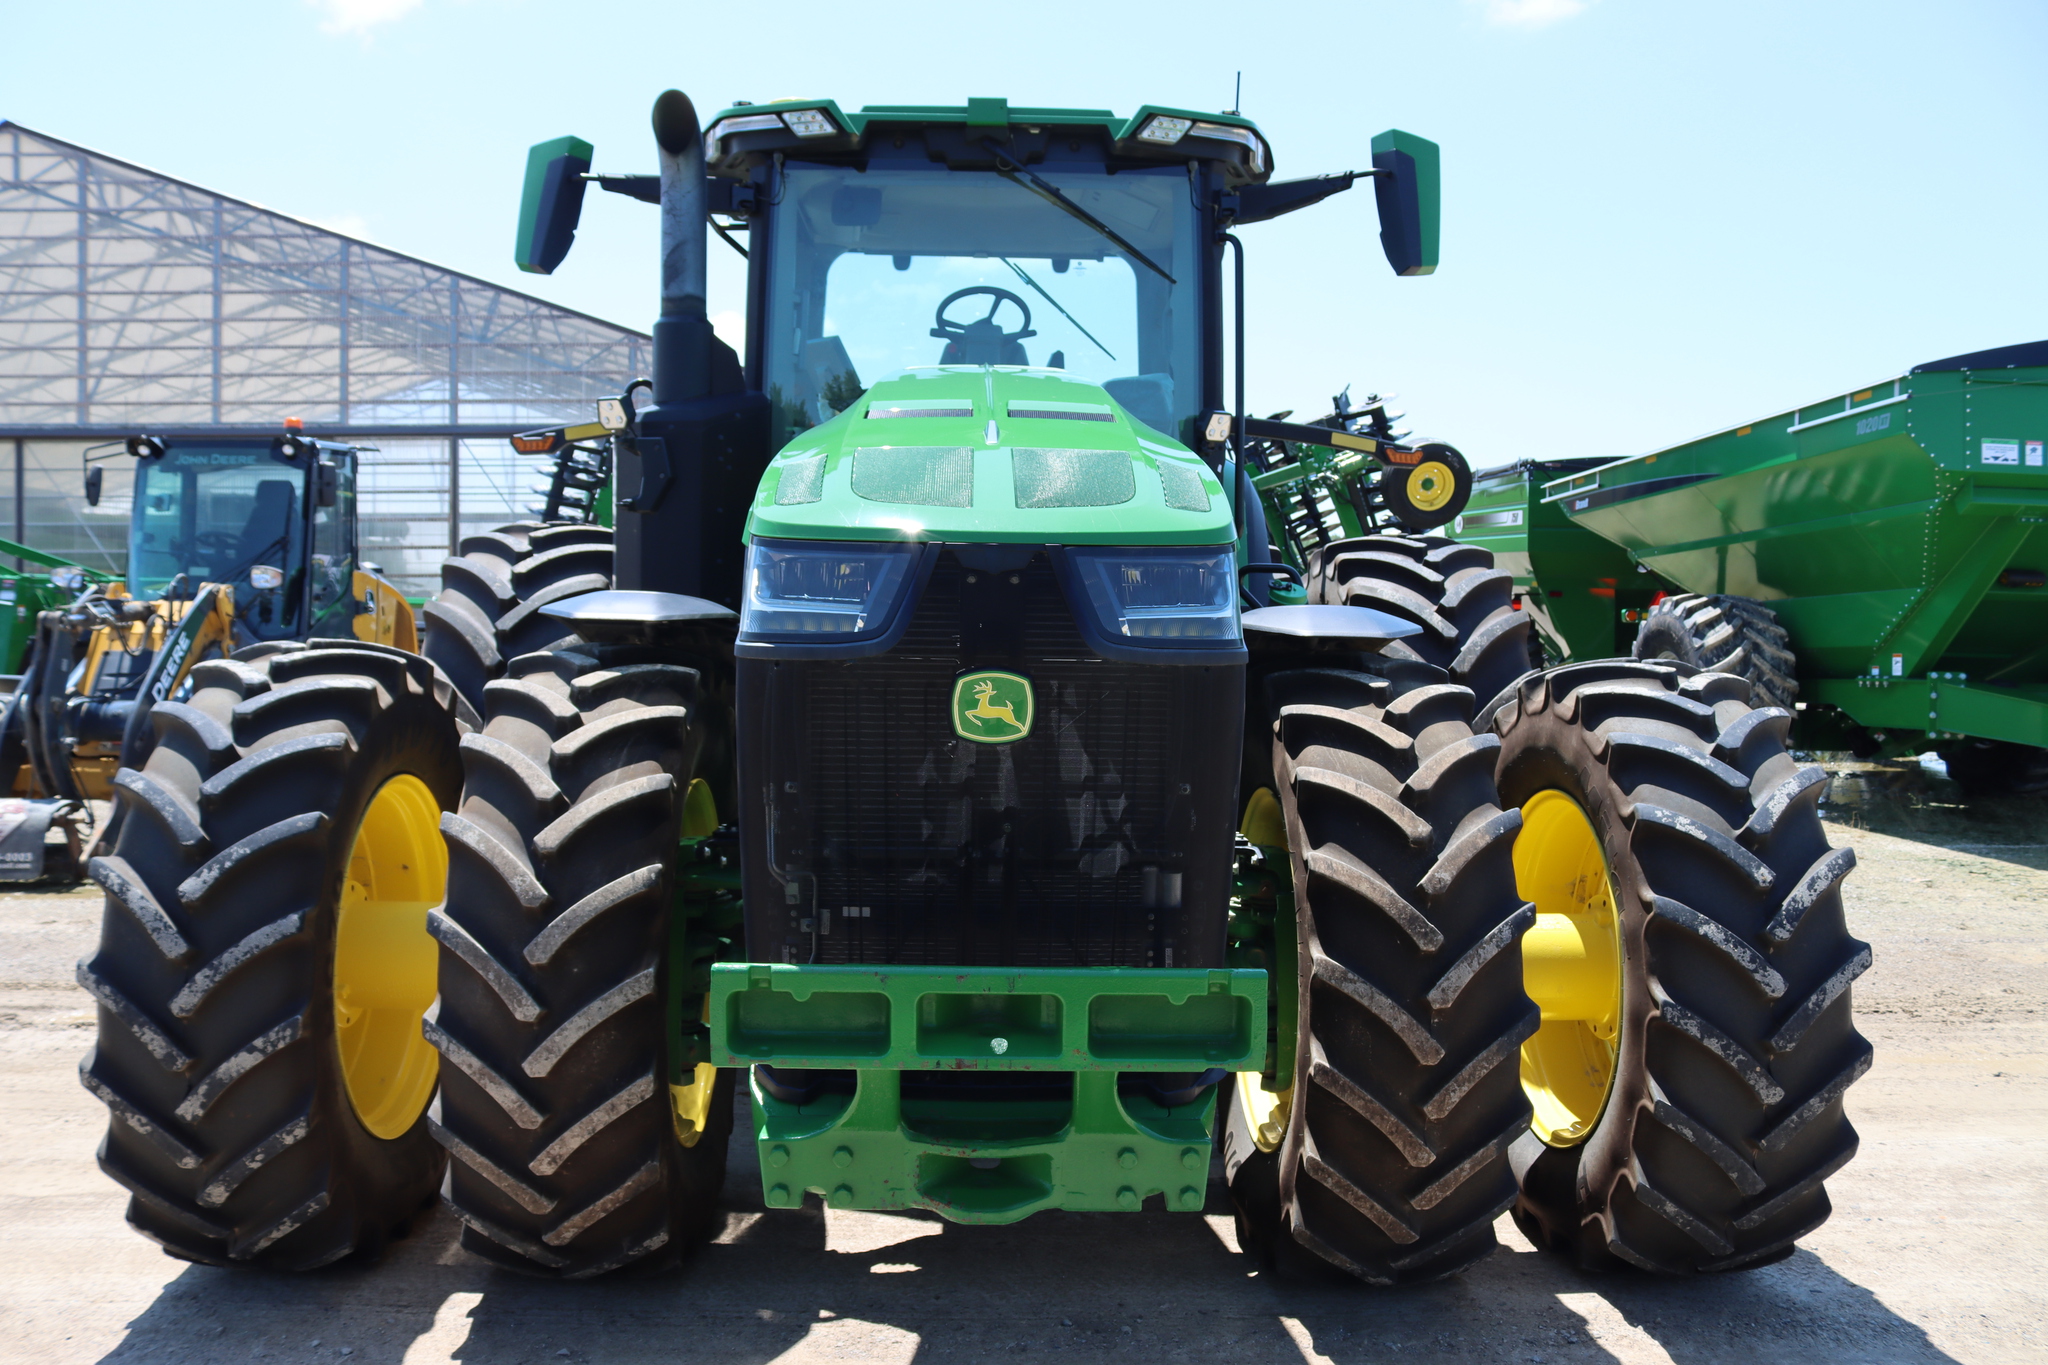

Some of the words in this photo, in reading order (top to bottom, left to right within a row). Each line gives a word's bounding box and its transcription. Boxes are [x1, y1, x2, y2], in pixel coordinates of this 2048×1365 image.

[174, 452, 208, 465] JOHN
[210, 453, 257, 465] DEERE
[151, 631, 191, 702] DEERE
